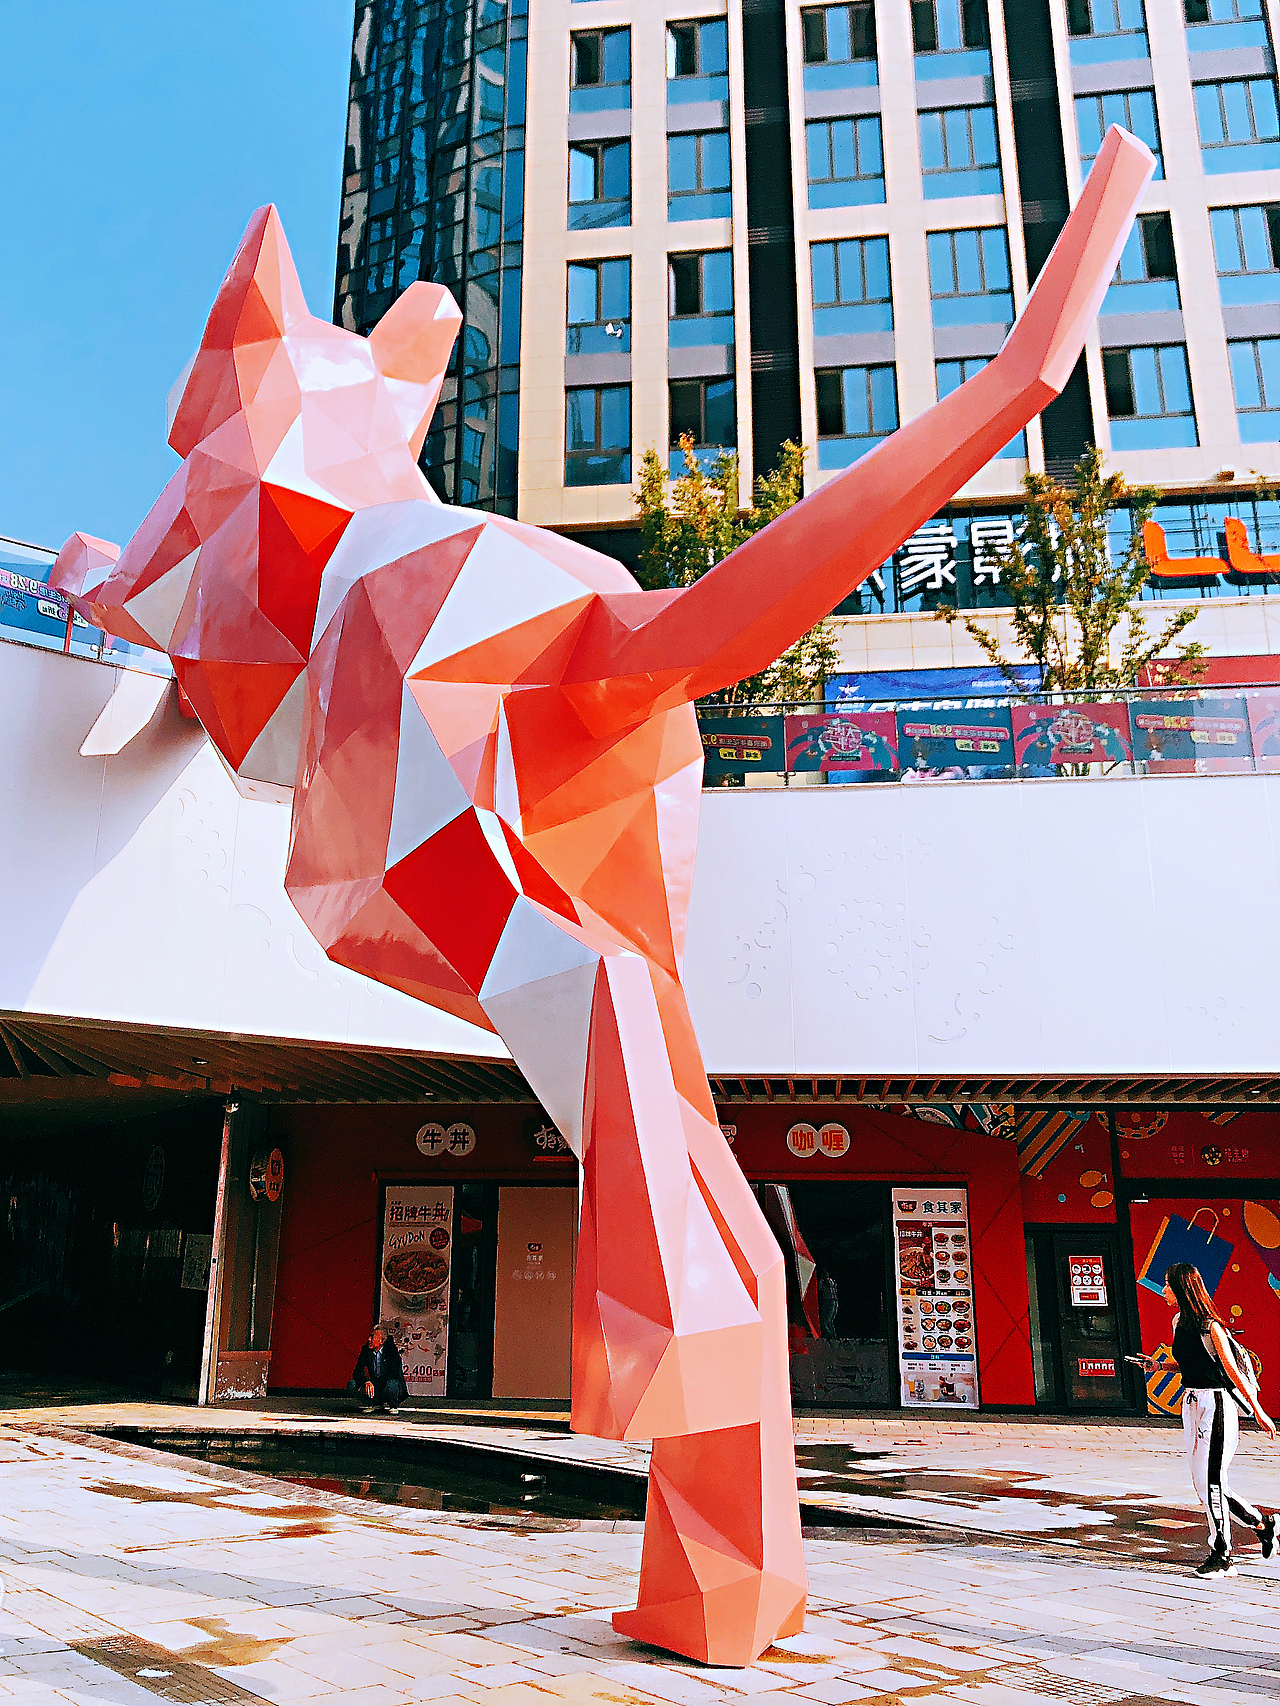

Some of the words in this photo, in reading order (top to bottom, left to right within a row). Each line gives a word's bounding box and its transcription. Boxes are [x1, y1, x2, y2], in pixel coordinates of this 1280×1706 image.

[791, 1129, 845, 1151] 咖喱
[921, 1201, 963, 1213] 食其家
